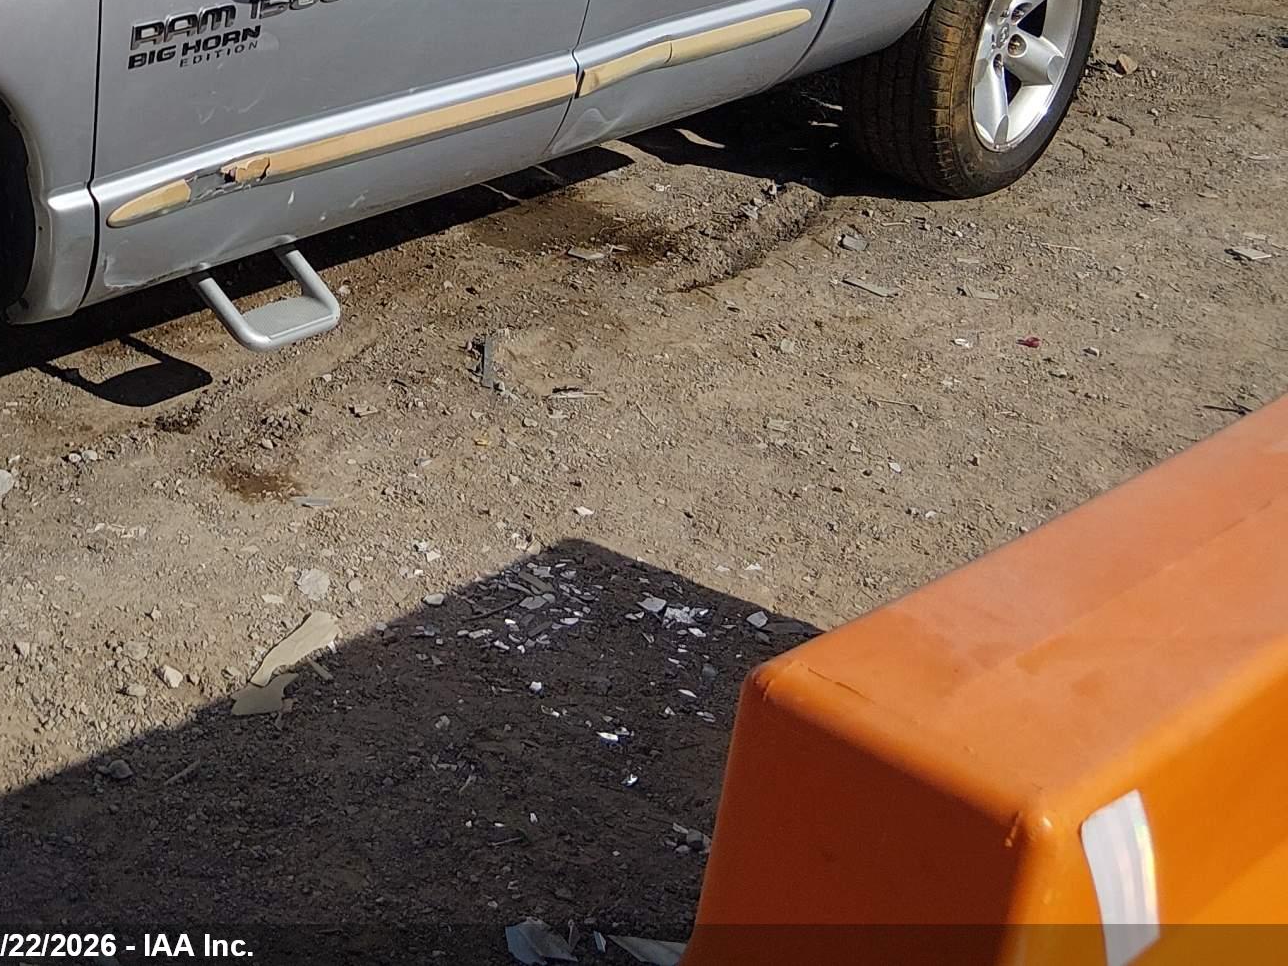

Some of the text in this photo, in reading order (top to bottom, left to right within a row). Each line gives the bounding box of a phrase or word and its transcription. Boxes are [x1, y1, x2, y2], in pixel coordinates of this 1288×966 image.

[127, 25, 262, 70] BIG HORN
[130, 2, 237, 51] RAM
[179, 40, 259, 69] EDITION
